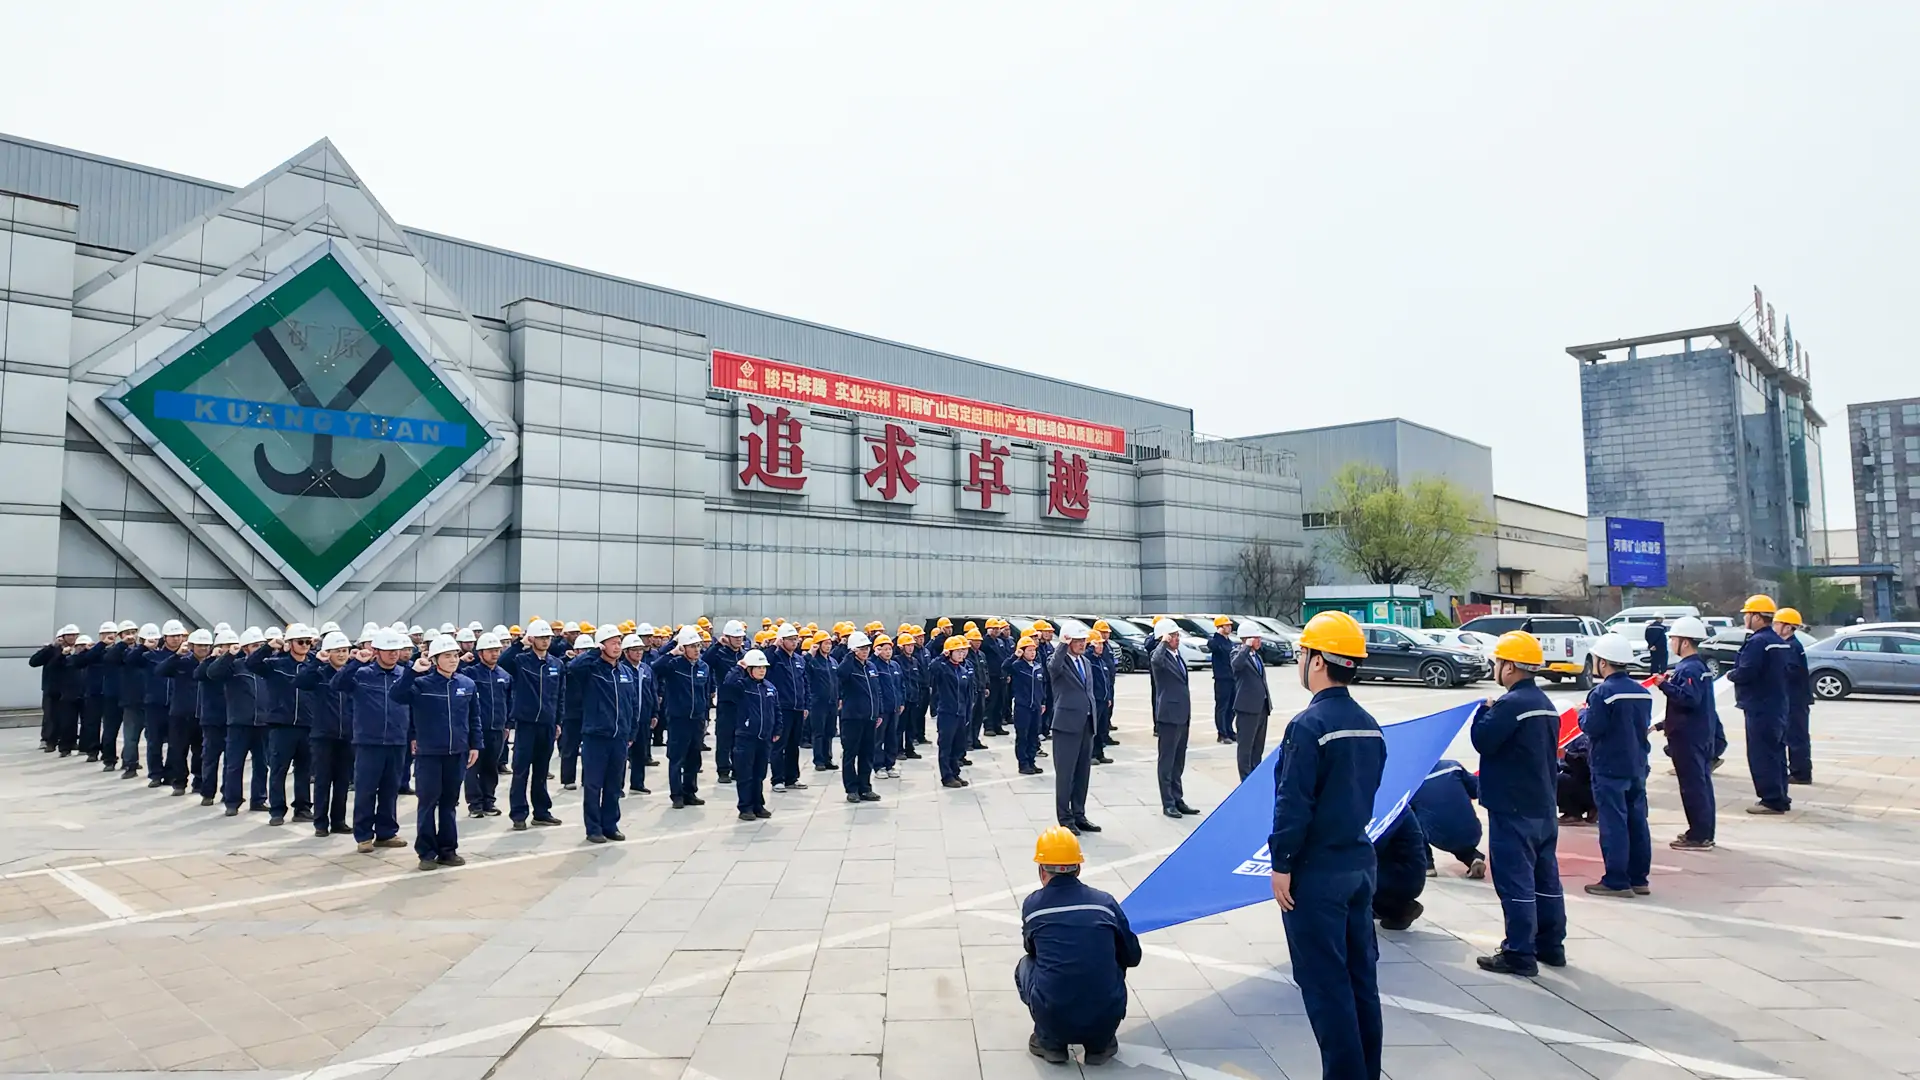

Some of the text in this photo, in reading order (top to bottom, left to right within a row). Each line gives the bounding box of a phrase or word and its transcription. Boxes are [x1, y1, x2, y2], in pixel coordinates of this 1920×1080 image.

[764, 368, 828, 398] 骏马奔腾
[835, 382, 890, 409] 实业兴邦
[739, 403, 1090, 519] 追求卓越
